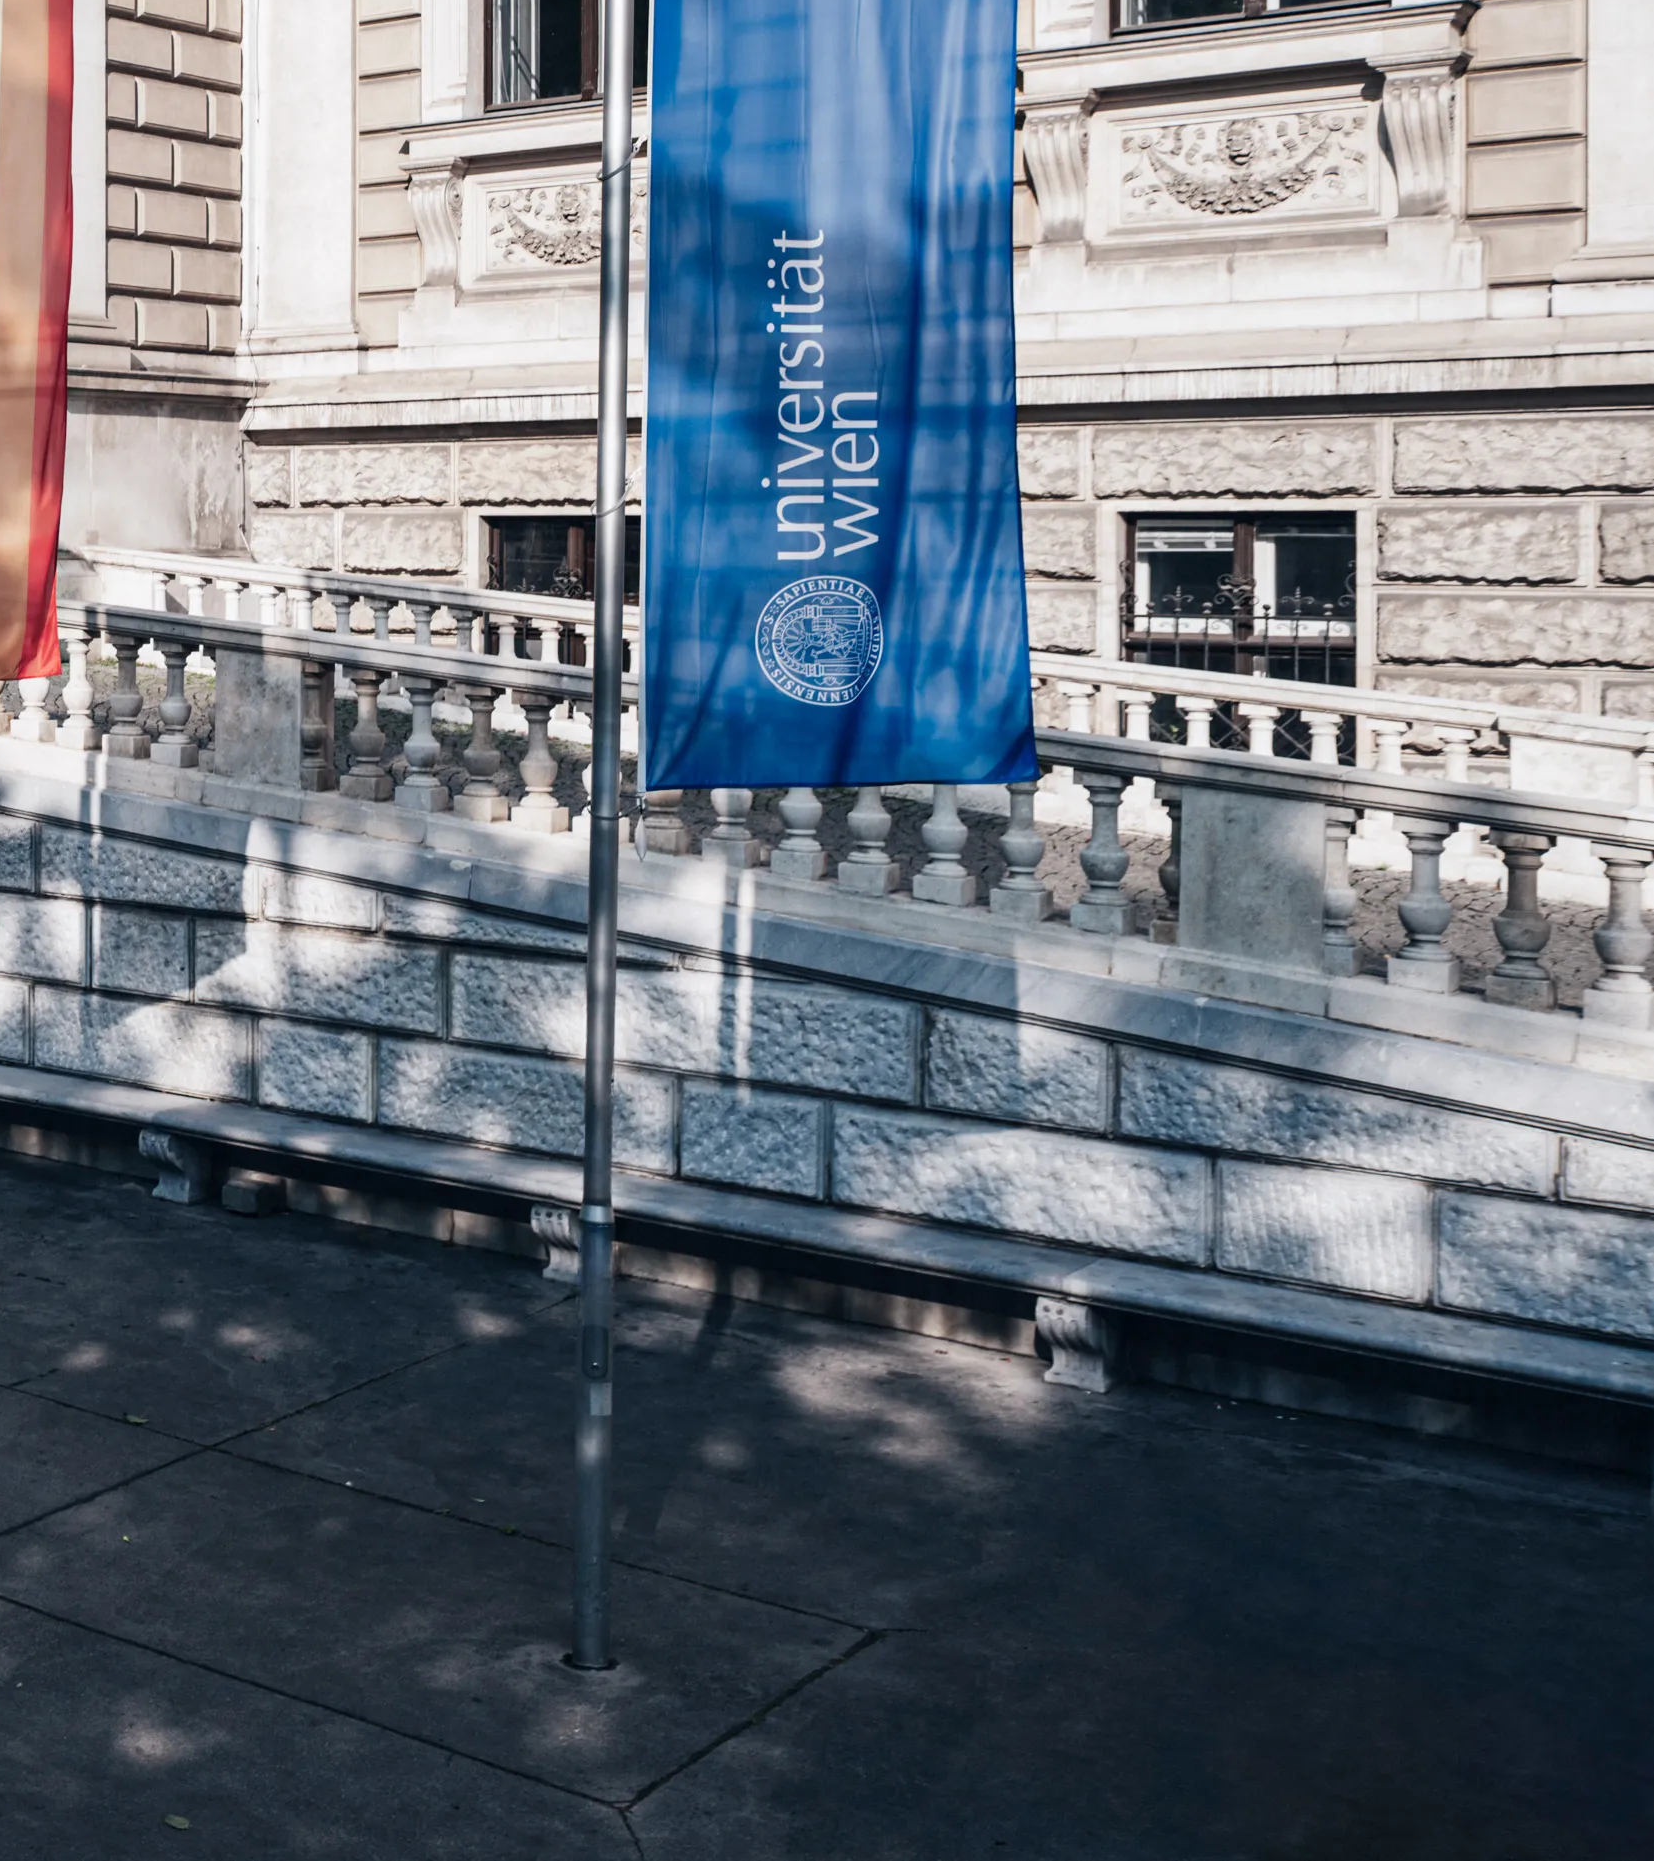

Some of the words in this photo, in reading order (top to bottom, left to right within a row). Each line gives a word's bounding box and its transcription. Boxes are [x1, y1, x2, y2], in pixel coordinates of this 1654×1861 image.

[761, 229, 826, 561] universität
[831, 391, 880, 557] wien
[775, 579, 866, 608] SAPIENTIAE
[771, 667, 860, 703] VIENNENSIS
